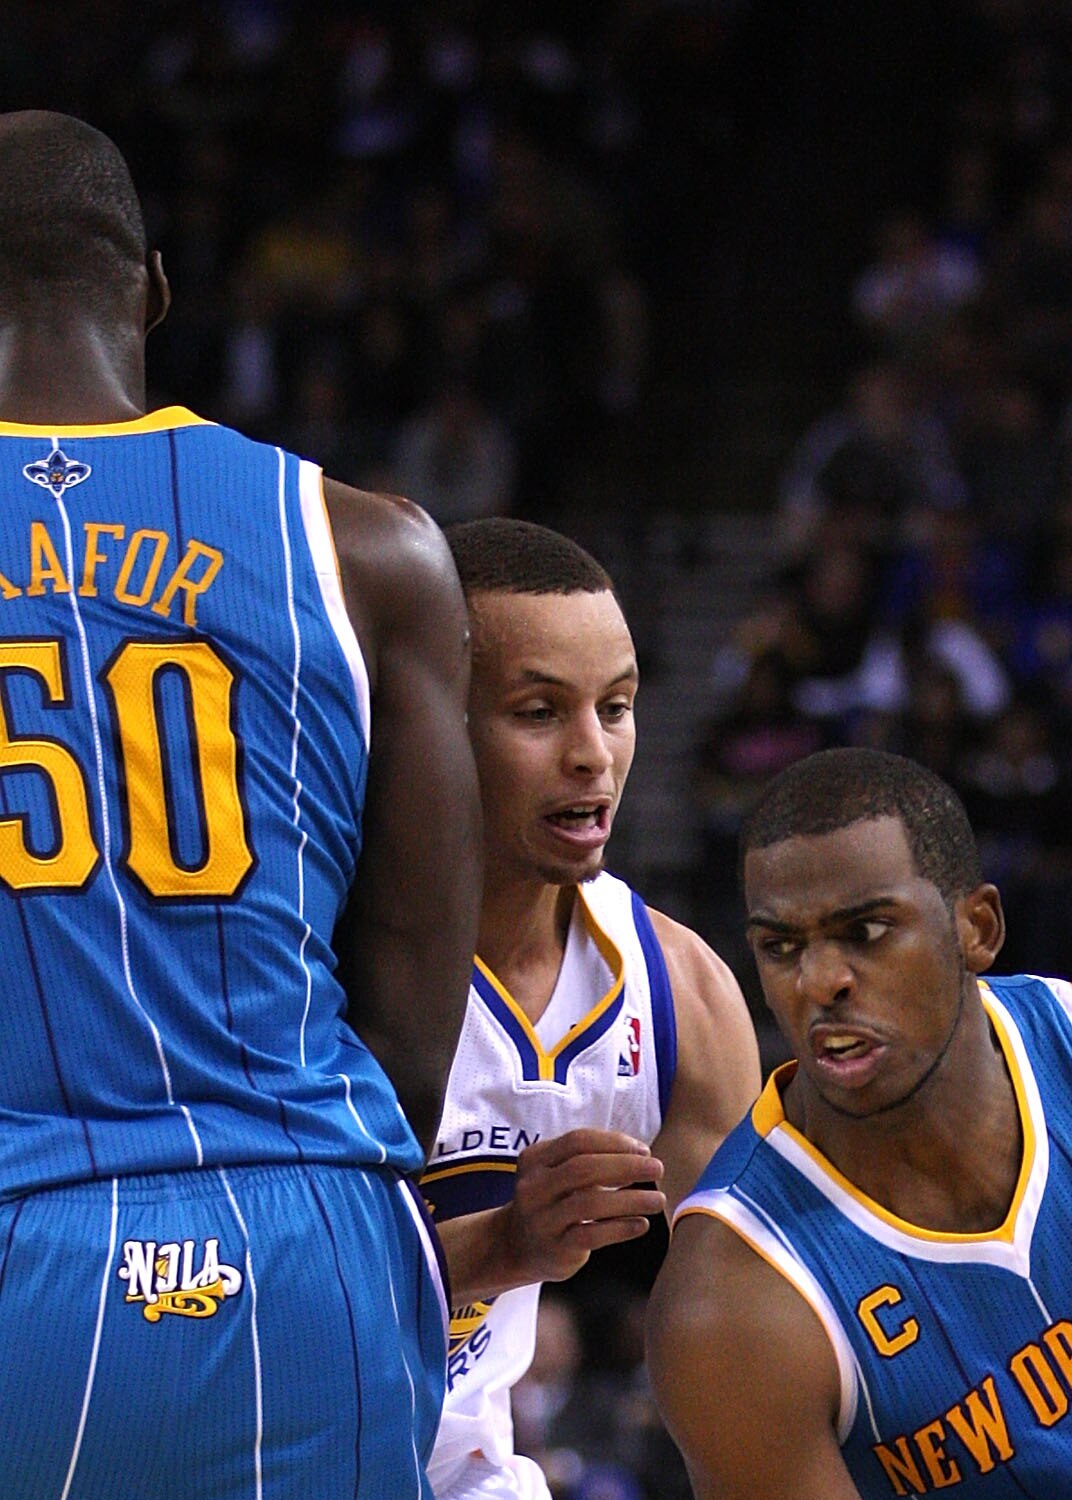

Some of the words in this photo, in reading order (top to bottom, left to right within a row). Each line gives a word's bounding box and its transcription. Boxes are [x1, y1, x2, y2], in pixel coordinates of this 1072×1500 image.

[0, 522, 223, 627] AFOR
[0, 635, 259, 904] 50
[437, 1126, 540, 1156] LDEN
[857, 1283, 919, 1358] C
[873, 1377, 1015, 1497] NEW
